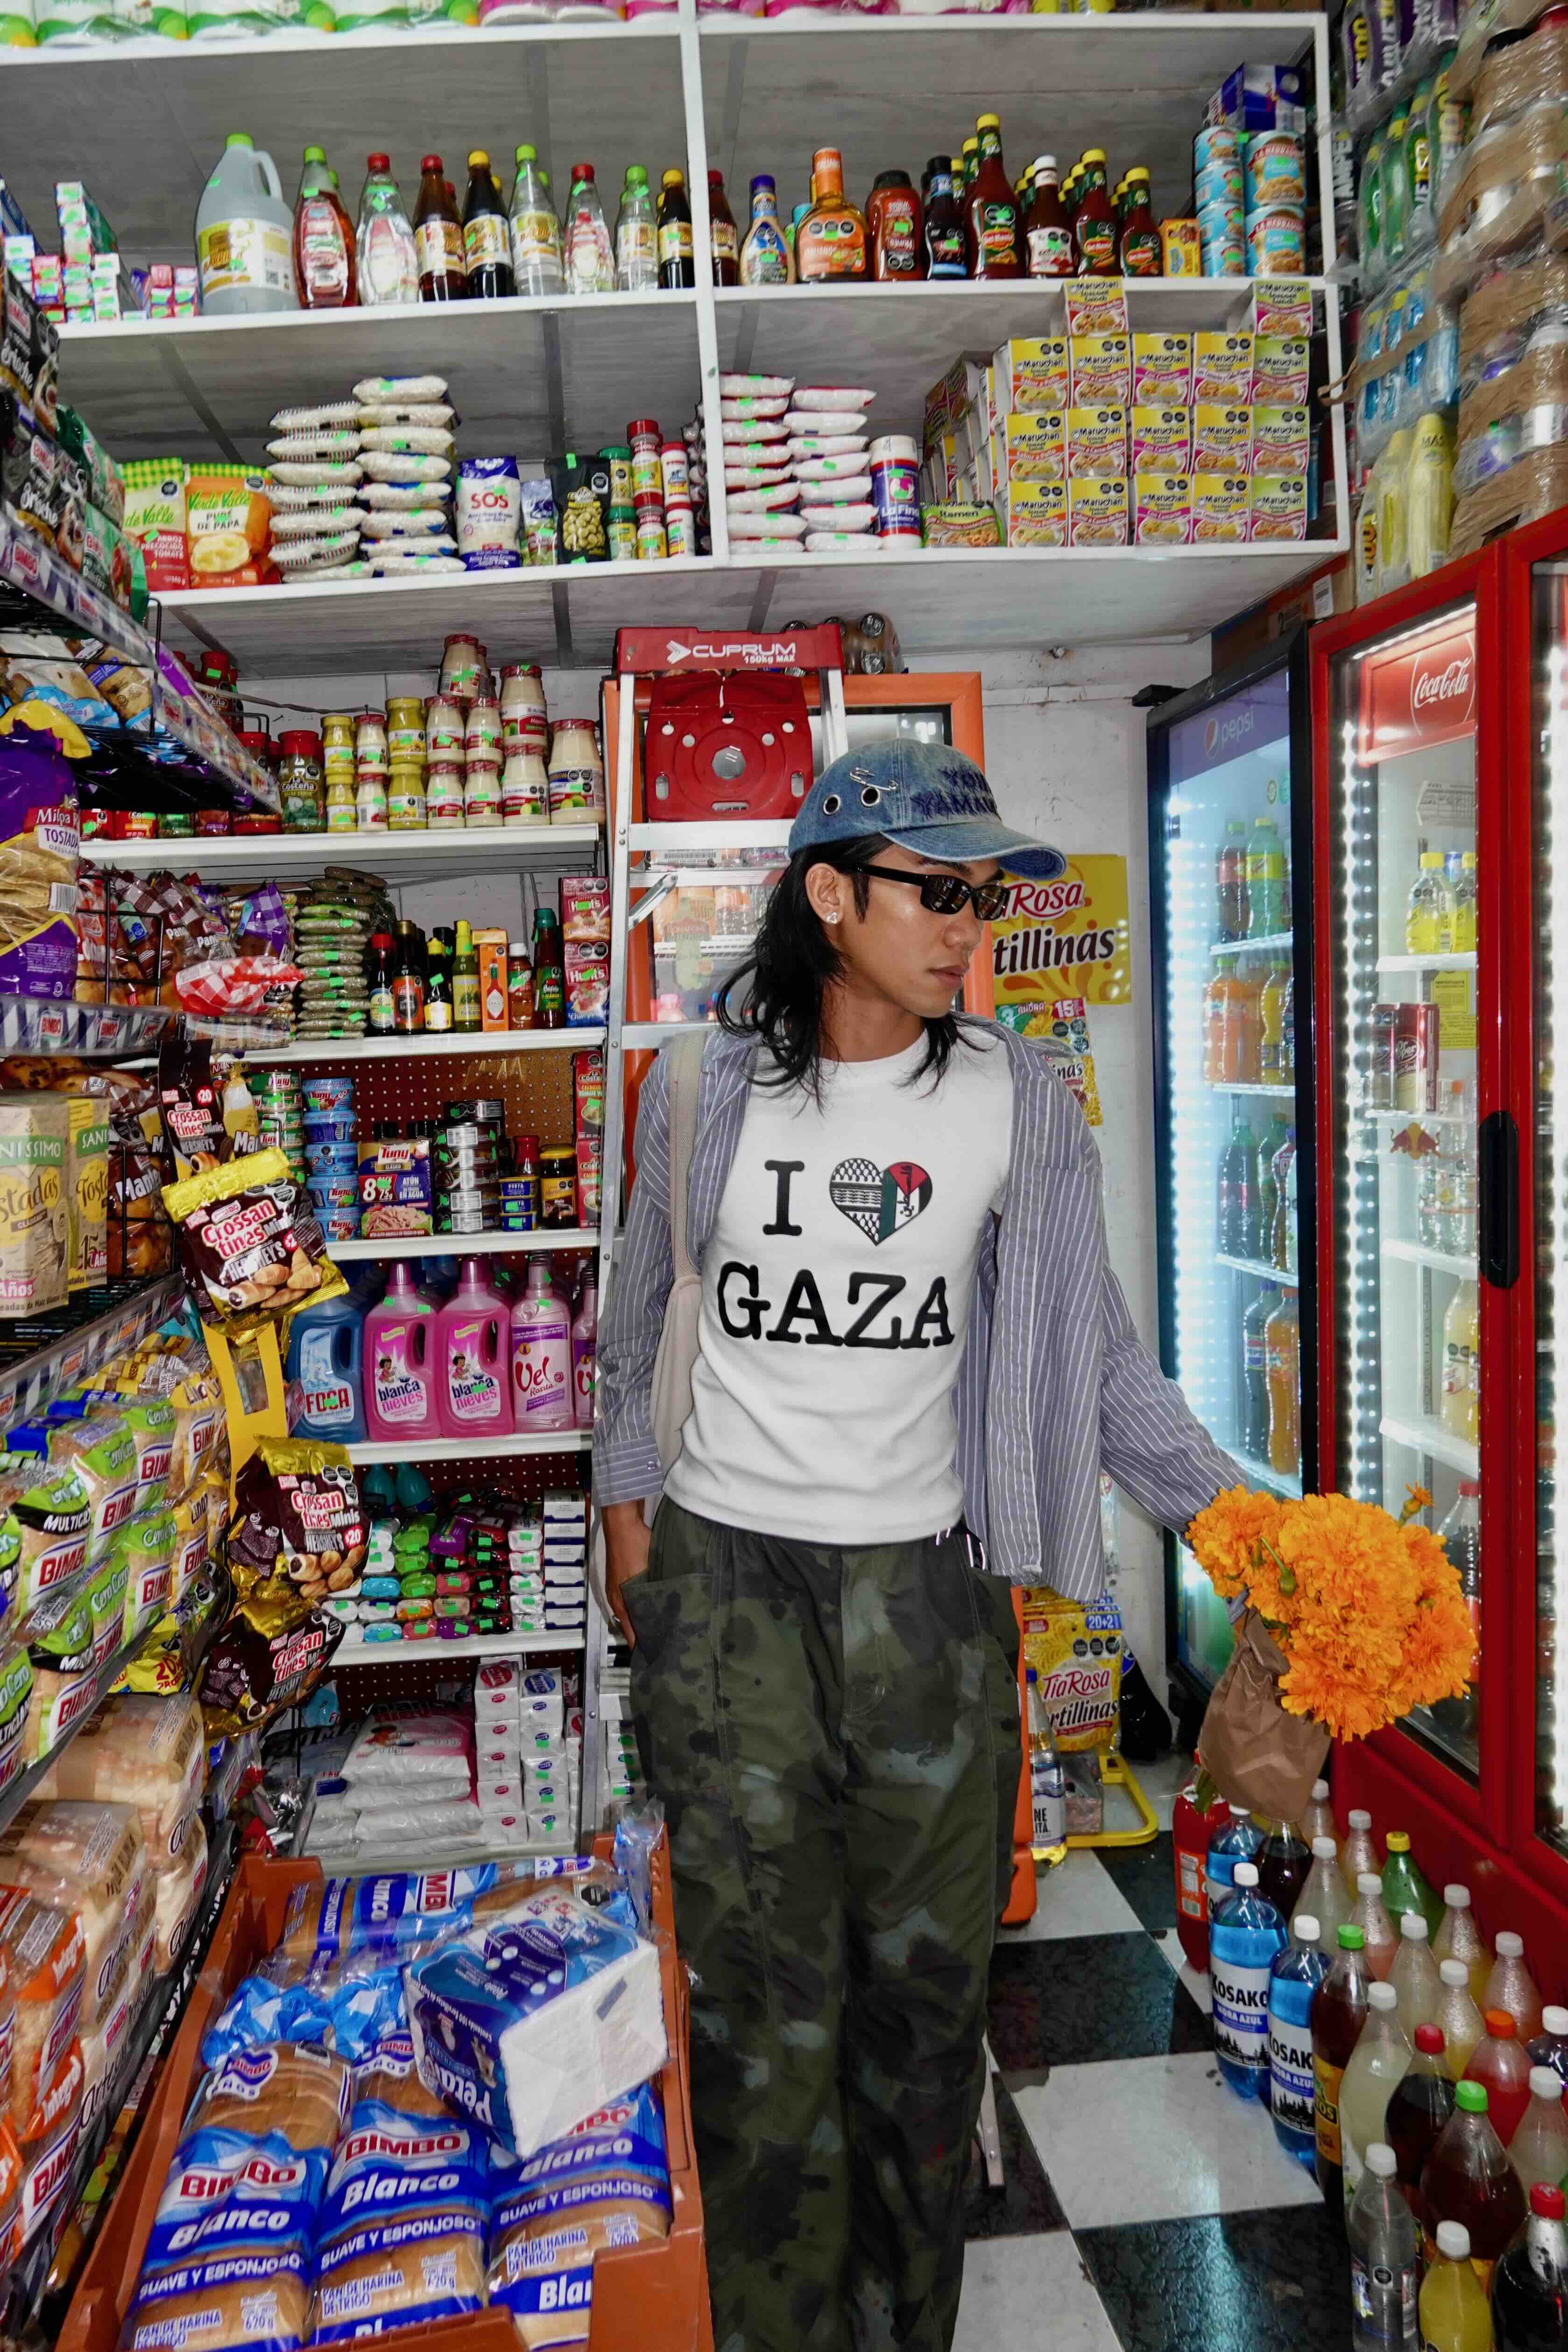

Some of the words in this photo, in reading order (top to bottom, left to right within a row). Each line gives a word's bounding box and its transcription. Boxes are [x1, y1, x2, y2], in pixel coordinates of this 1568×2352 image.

[188, 491, 219, 509] Verde
[221, 489, 251, 508] Valle
[470, 492, 509, 509] SOS
[142, 503, 174, 524] Valle
[692, 642, 796, 658] CUPRUM
[744, 655, 775, 665] 150kg
[776, 654, 795, 663] MAX
[1221, 706, 1255, 743] pepsi
[37, 808, 70, 827] Milpa
[44, 828, 79, 849] TOSTADA
[994, 927, 1116, 976] tillinas
[269, 1075, 290, 1088] Tuny
[168, 1109, 211, 1123] Crossan
[0, 1140, 61, 1160] NISSIMO
[381, 1145, 410, 1160] Tuny
[363, 1177, 377, 1201] 8
[402, 1175, 419, 1187] ATÚN
[0, 1173, 59, 1222] stadas
[399, 1191, 411, 1200] EN
[412, 1190, 424, 1200] AGUA
[763, 1159, 805, 1236] I
[203, 1201, 274, 1244] Crossan
[218, 1226, 266, 1257] tines
[717, 1260, 955, 1349] GAZA
[515, 1356, 550, 1392] Vel
[378, 1379, 420, 1401] blanca
[381, 1391, 424, 1413] nieves
[456, 1387, 498, 1409] nieves
[530, 1383, 553, 1397] Rosita
[141, 1449, 172, 1480] BIM
[43, 1507, 90, 1533] MULTIGR
[39, 1545, 86, 1587] BIMB
[1069, 1669, 1110, 1697] Rosa
[1049, 1699, 1118, 1728] rtillinas
[1239, 2013, 1263, 2026] AZUL
[1269, 2031, 1314, 2070] KOSAK
[1292, 2073, 1314, 2085] AZU
[345, 2135, 461, 2162] BIMBO
[518, 2138, 633, 2182] Blanco
[341, 2172, 459, 2214] Blanco
[500, 2198, 546, 2224] SUAVE
[549, 2193, 560, 2207] Y
[562, 2181, 654, 2204] ESPONJOSO
[167, 2207, 290, 2252] Blanco
[320, 2238, 366, 2270] SUAVE
[368, 2229, 380, 2246] Y
[382, 2218, 475, 2245] ESPONJOSO
[508, 2244, 527, 2259] PAN
[530, 2241, 543, 2253] DE
[546, 2230, 586, 2249] HARINA
[522, 2250, 556, 2268] TRIGO
[139, 2268, 188, 2301] SUAVE
[191, 2267, 203, 2286] Y
[205, 2252, 300, 2283] ESPONJOSO
[363, 2272, 403, 2292] HARINA
[338, 2294, 370, 2312] TRIGO
[539, 2276, 592, 2311] Bla
[178, 2310, 221, 2329] HARINA
